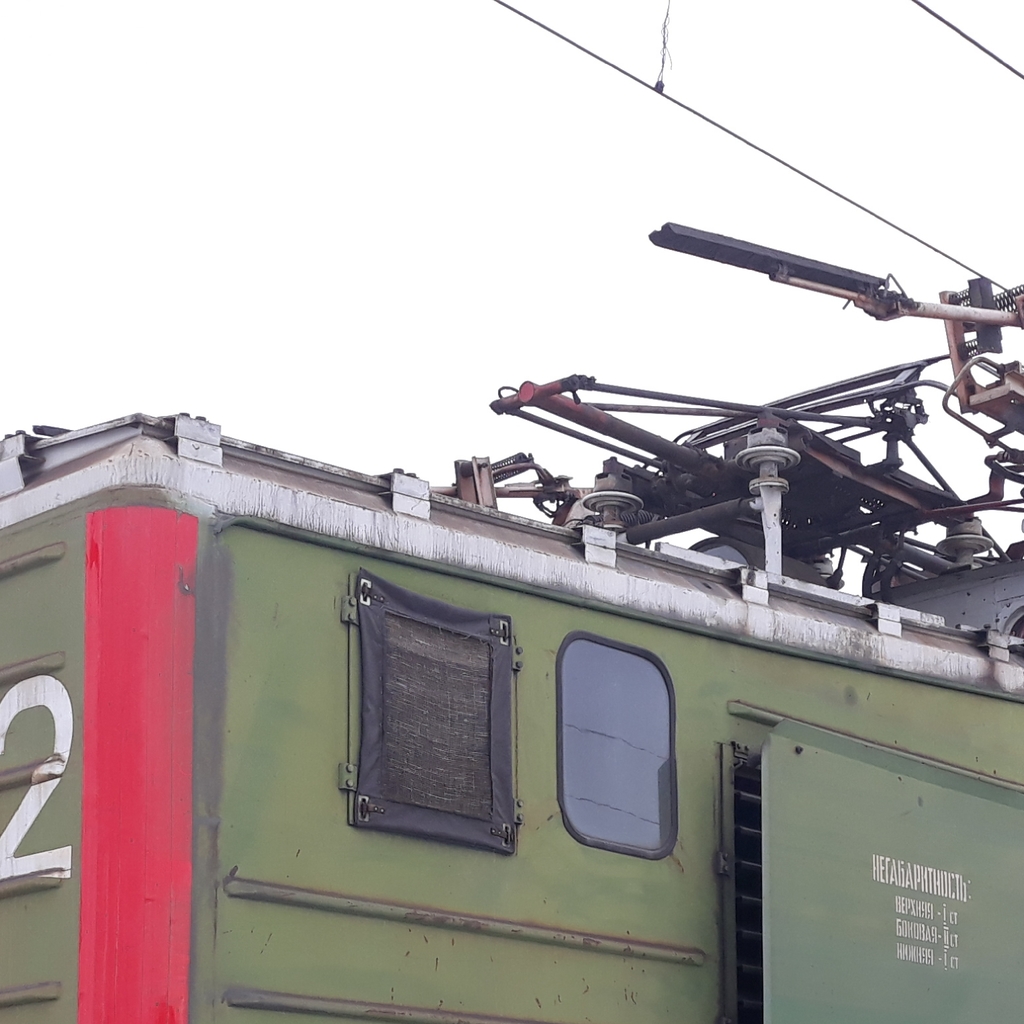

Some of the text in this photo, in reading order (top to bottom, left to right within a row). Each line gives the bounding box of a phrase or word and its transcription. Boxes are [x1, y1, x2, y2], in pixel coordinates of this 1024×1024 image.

[0, 674, 74, 882] 2
[872, 853, 972, 903] НЕГАБАРИТНОСТЬ:
[895, 895, 934, 920] ВЕРХНЯЯ
[896, 942, 934, 966] НИЖНЯЯ
